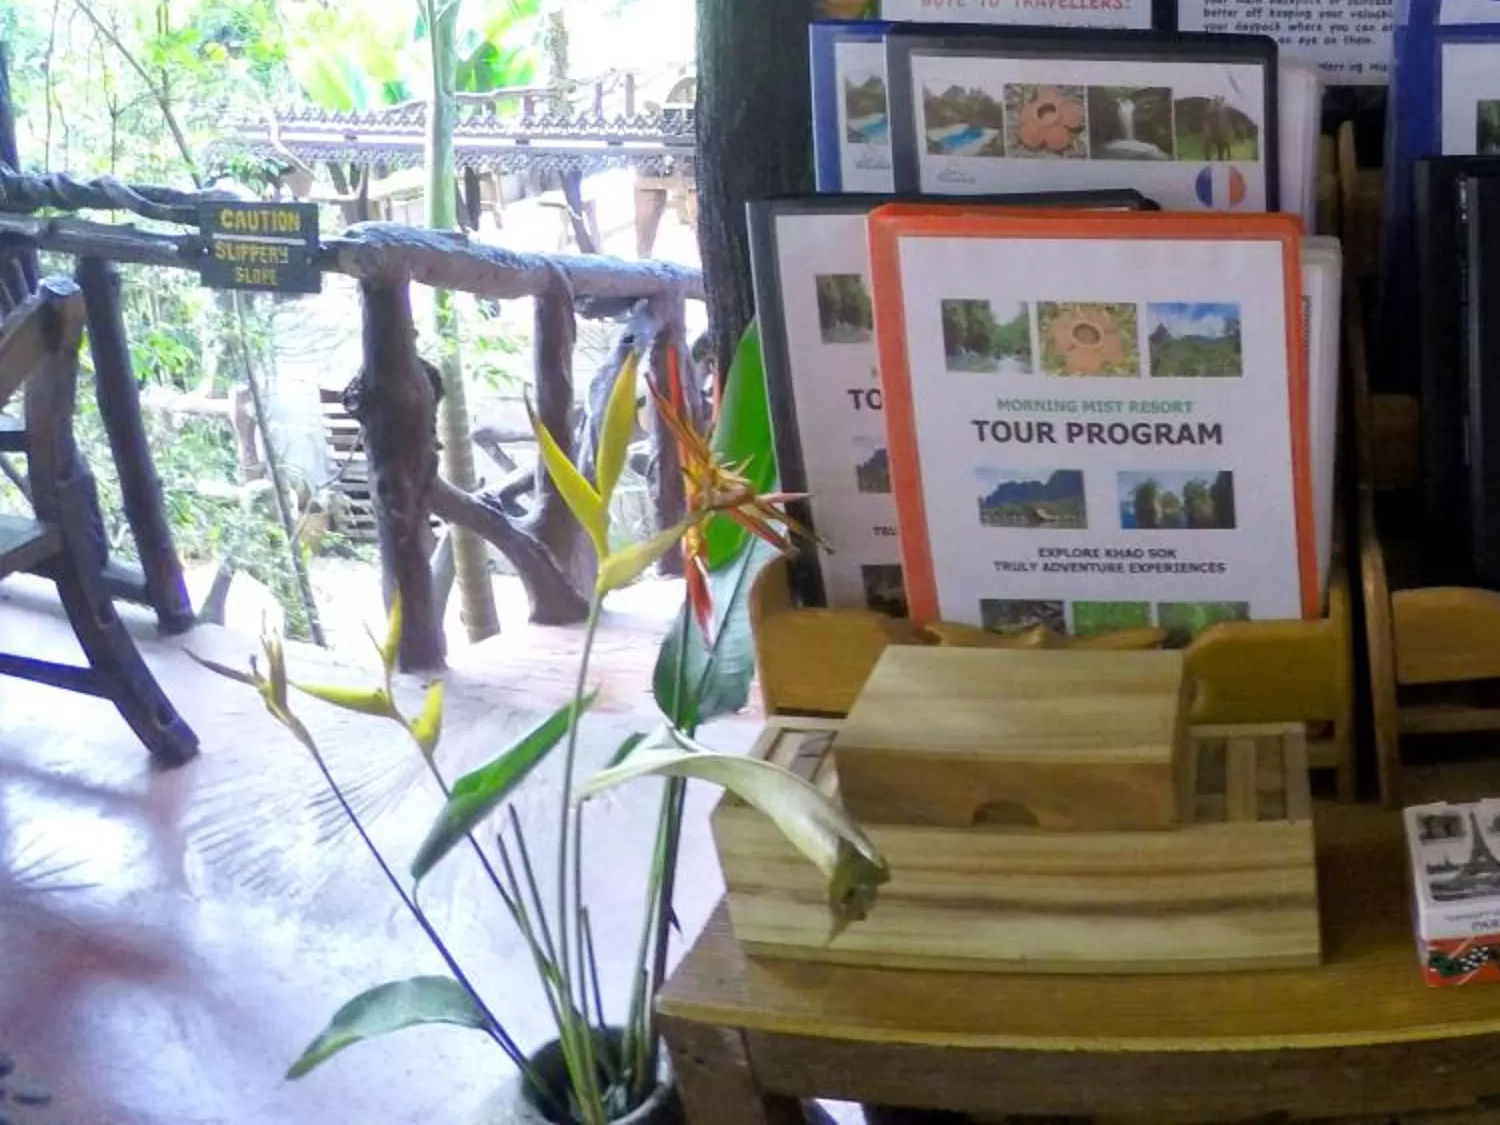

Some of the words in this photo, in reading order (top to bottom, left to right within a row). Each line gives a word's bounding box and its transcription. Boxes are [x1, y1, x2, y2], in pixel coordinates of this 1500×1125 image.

[220, 208, 300, 232] CAUTION
[996, 398, 1077, 413] MORNING
[1080, 400, 1122, 413] MIST
[1129, 400, 1193, 414] RESORT
[971, 419, 1056, 444] TOUR
[1066, 422, 1223, 446] PROGRAM
[1037, 548, 1100, 558] EXPLORE
[1104, 548, 1145, 558] KHAO
[1148, 548, 1177, 558] SOK
[1042, 562, 1125, 573] ADVENTURE
[1129, 562, 1228, 573] EXPERIENCES
